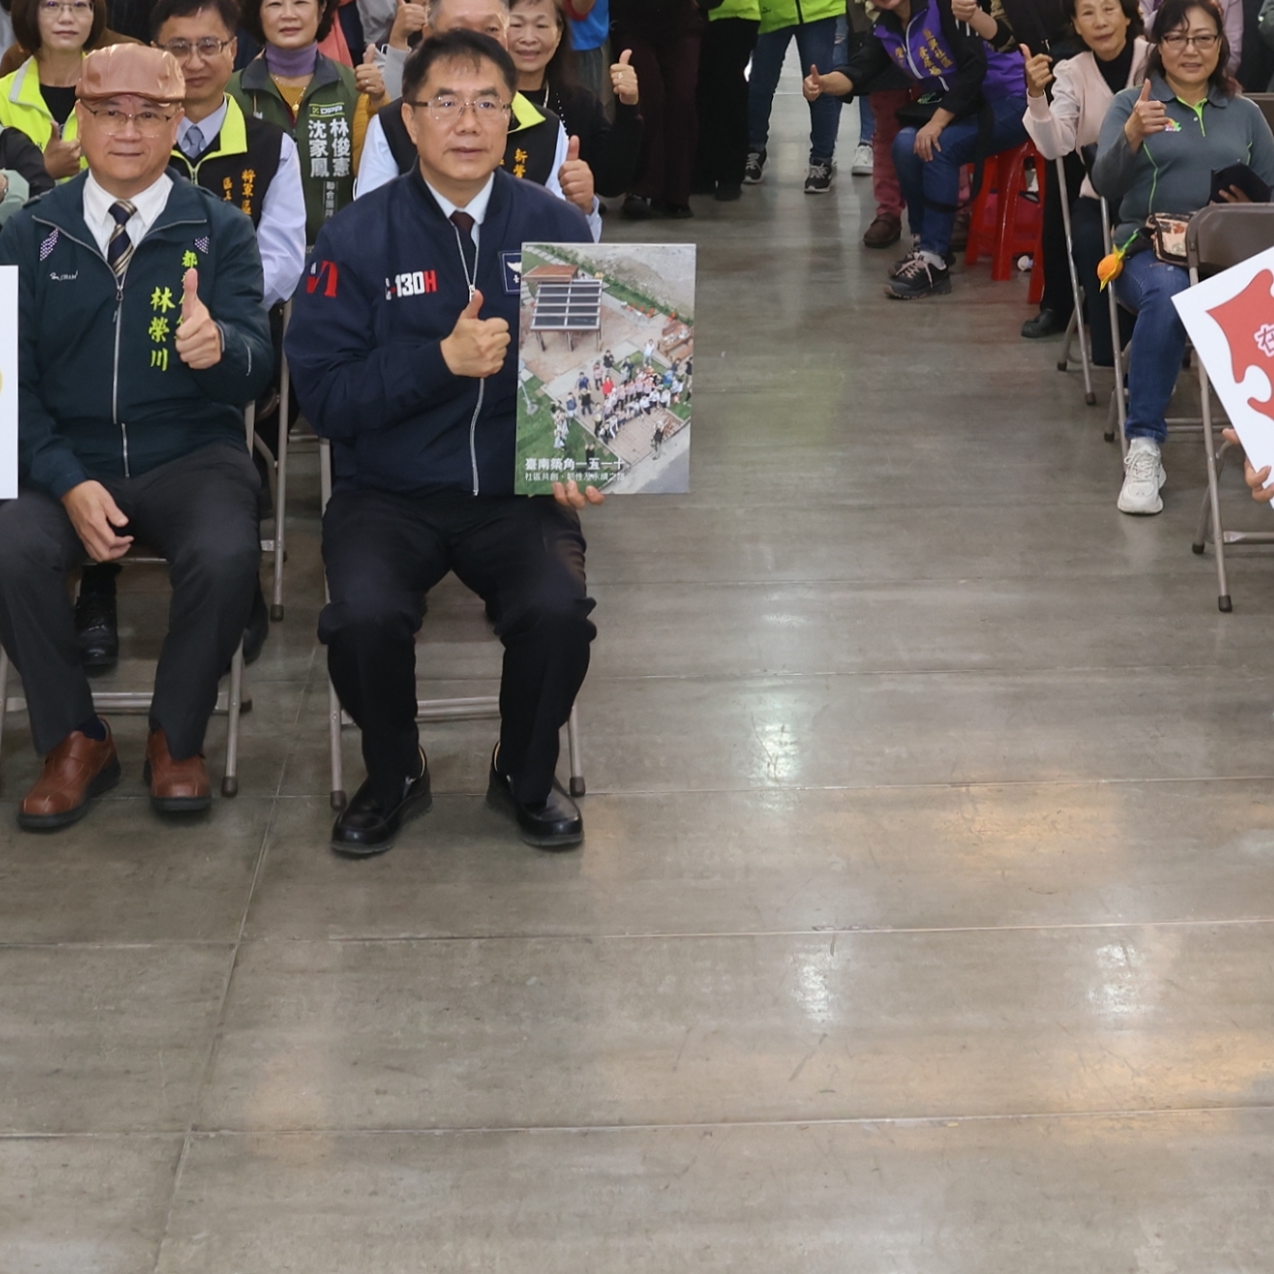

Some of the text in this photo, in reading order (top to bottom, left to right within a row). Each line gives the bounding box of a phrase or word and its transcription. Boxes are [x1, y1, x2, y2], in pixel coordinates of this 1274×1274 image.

[320, 105, 343, 114] DPP
[330, 118, 350, 177] 林俊憲
[148, 286, 176, 371] 林榮川
